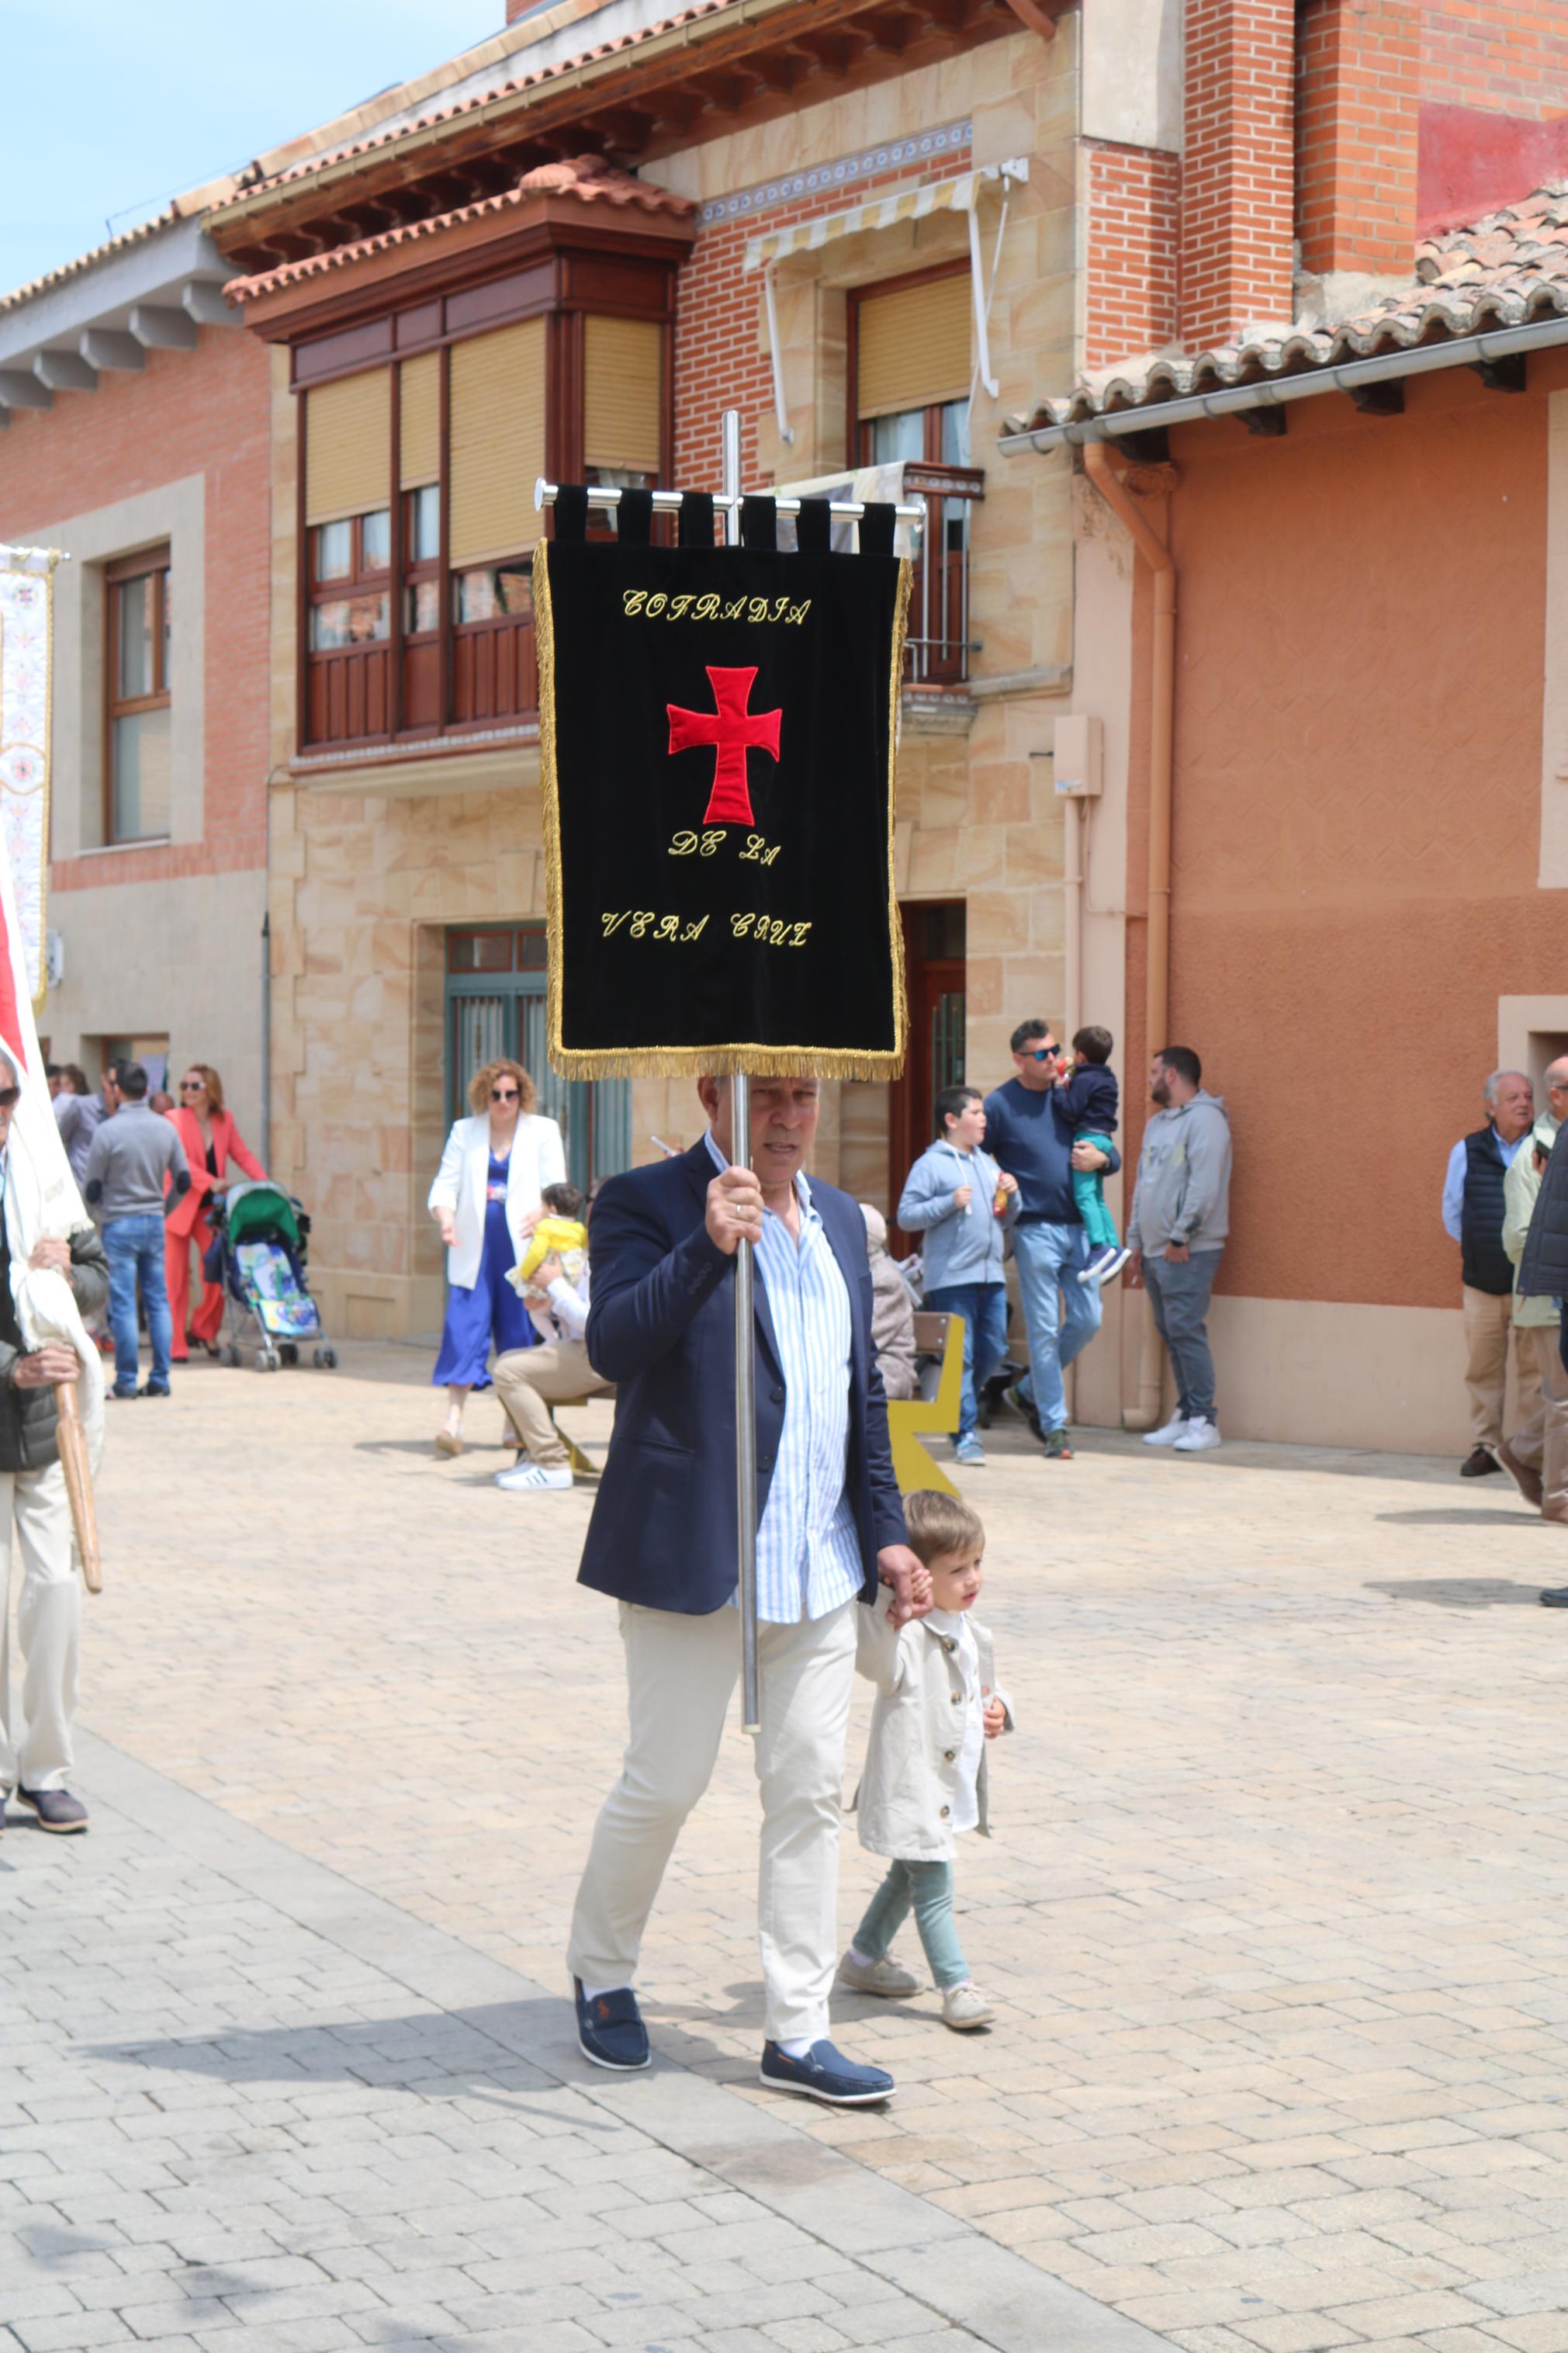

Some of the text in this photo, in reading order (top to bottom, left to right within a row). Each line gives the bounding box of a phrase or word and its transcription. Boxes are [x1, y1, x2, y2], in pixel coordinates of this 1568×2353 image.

[623, 589, 812, 626] COFRADIA
[668, 830, 781, 866] DE LA
[601, 910, 812, 947] VERA CRUZ
